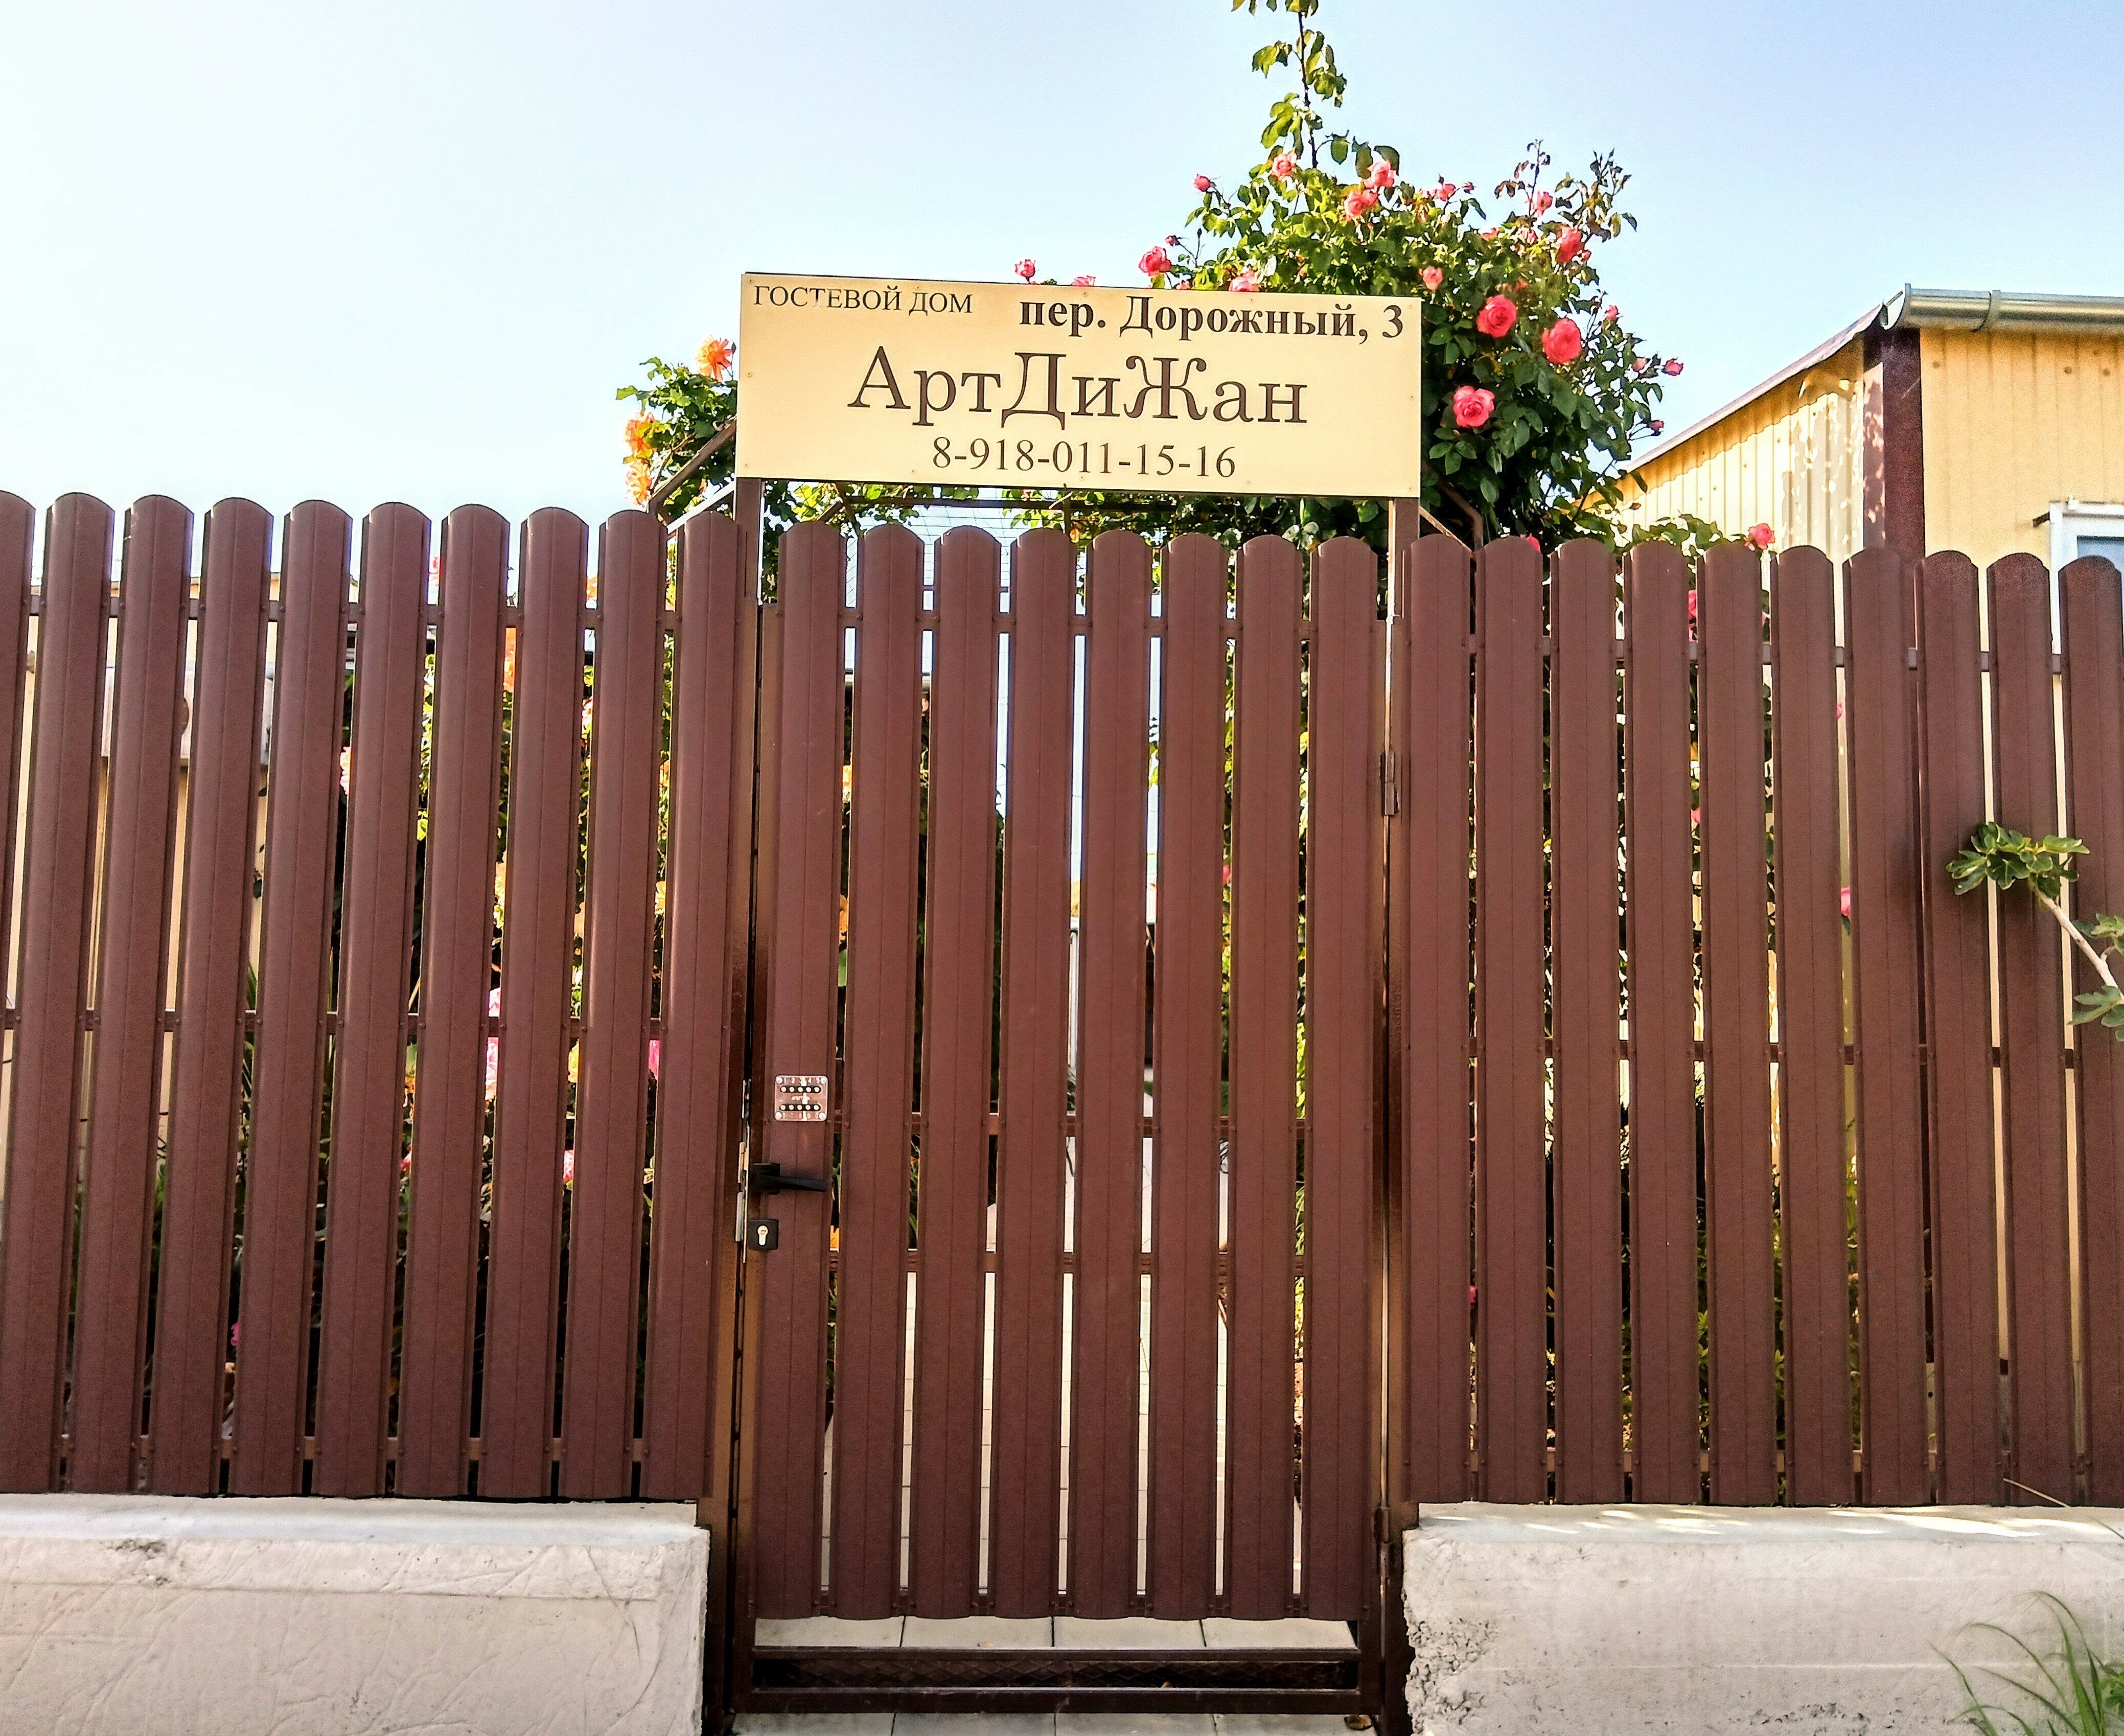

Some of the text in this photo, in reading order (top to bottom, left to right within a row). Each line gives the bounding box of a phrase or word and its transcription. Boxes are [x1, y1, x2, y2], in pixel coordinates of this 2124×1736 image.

[754, 285, 973, 316] ГОСТЕВОЙ ДОМ
[1019, 295, 1403, 345] пер. Дорожный, 3
[847, 345, 1307, 430] АртДиЖан
[933, 436, 1235, 478] 8-918-011-15-16
